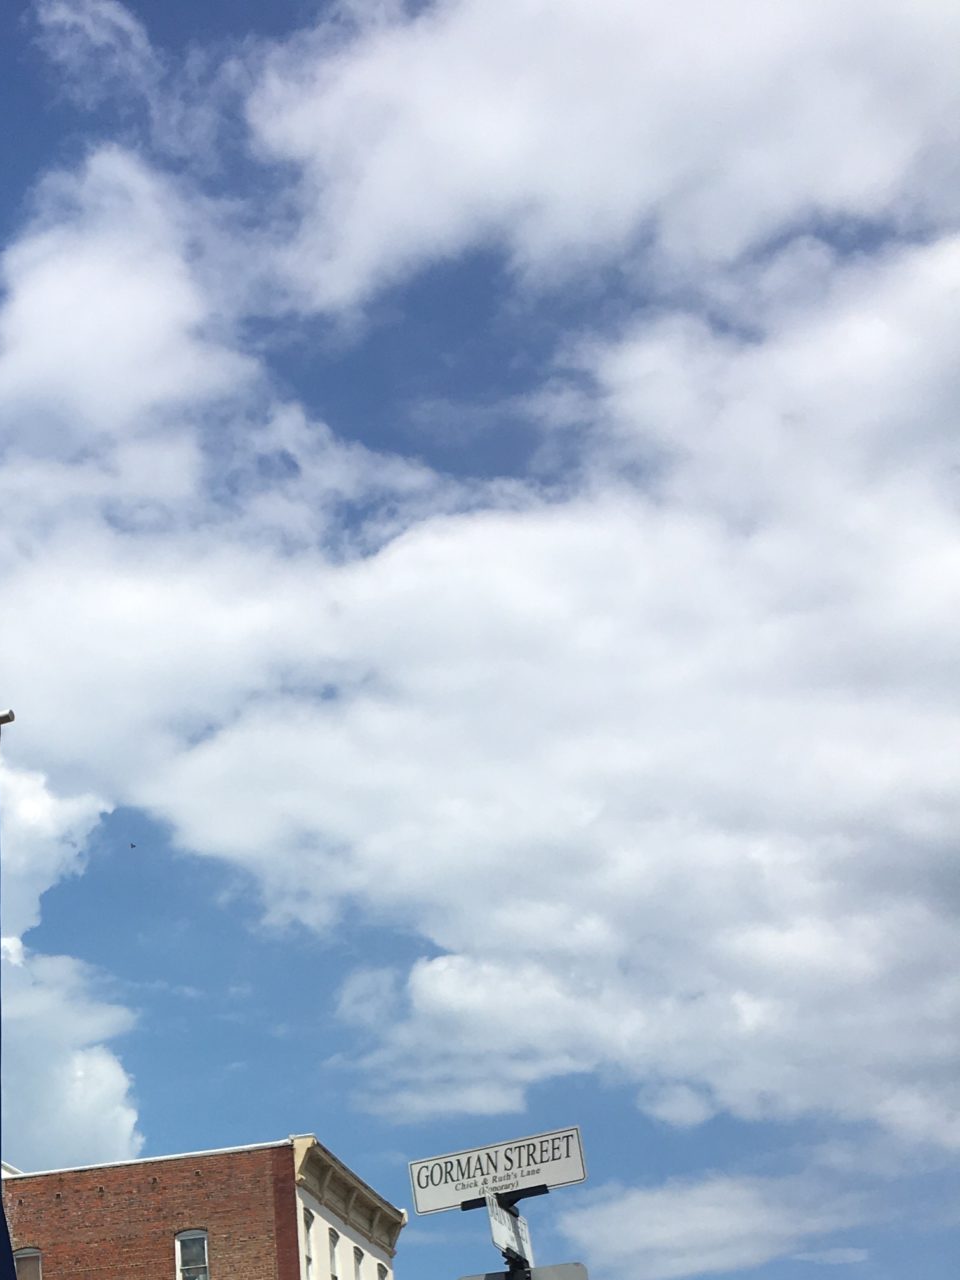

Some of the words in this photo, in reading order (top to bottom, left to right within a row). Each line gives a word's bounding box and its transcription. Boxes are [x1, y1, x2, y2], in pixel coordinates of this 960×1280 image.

[417, 1151, 499, 1190] GORMAN
[503, 1134, 574, 1171] STREET
[455, 1180, 478, 1192] Chick
[481, 1177, 489, 1186] &
[492, 1171, 518, 1183] Ruth's
[520, 1168, 541, 1178] Lane
